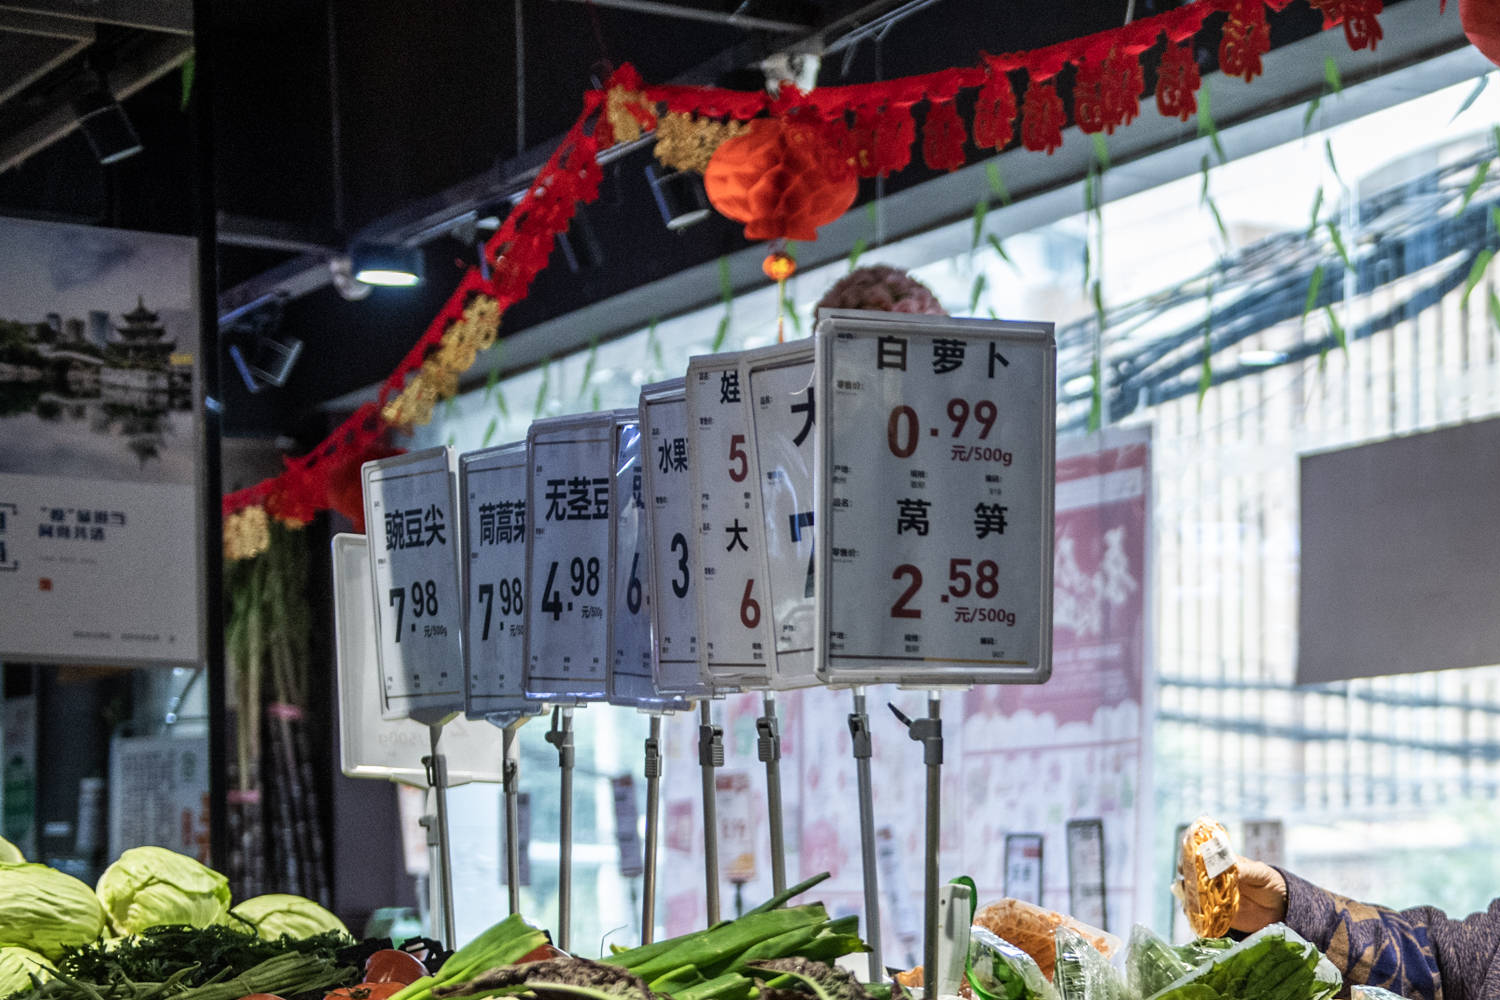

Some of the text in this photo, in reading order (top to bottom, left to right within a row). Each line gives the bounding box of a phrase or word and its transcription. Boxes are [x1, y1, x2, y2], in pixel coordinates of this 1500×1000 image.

[876, 335, 1010, 378] 白萝卜
[888, 398, 998, 458] 0.99
[658, 438, 689, 474] 水果
[728, 434, 748, 483] 5
[951, 445, 1013, 467] 元/500g
[384, 504, 447, 551] 豌豆尖
[726, 519, 749, 553] 大
[896, 499, 1009, 540] 莴笋
[541, 557, 601, 621] 4.98
[671, 532, 690, 599] 3
[891, 558, 999, 619] 2.58
[389, 579, 439, 643] 7.98
[478, 577, 524, 641] 7.98
[740, 579, 762, 630] 6
[954, 606, 1016, 627] 元/500g
